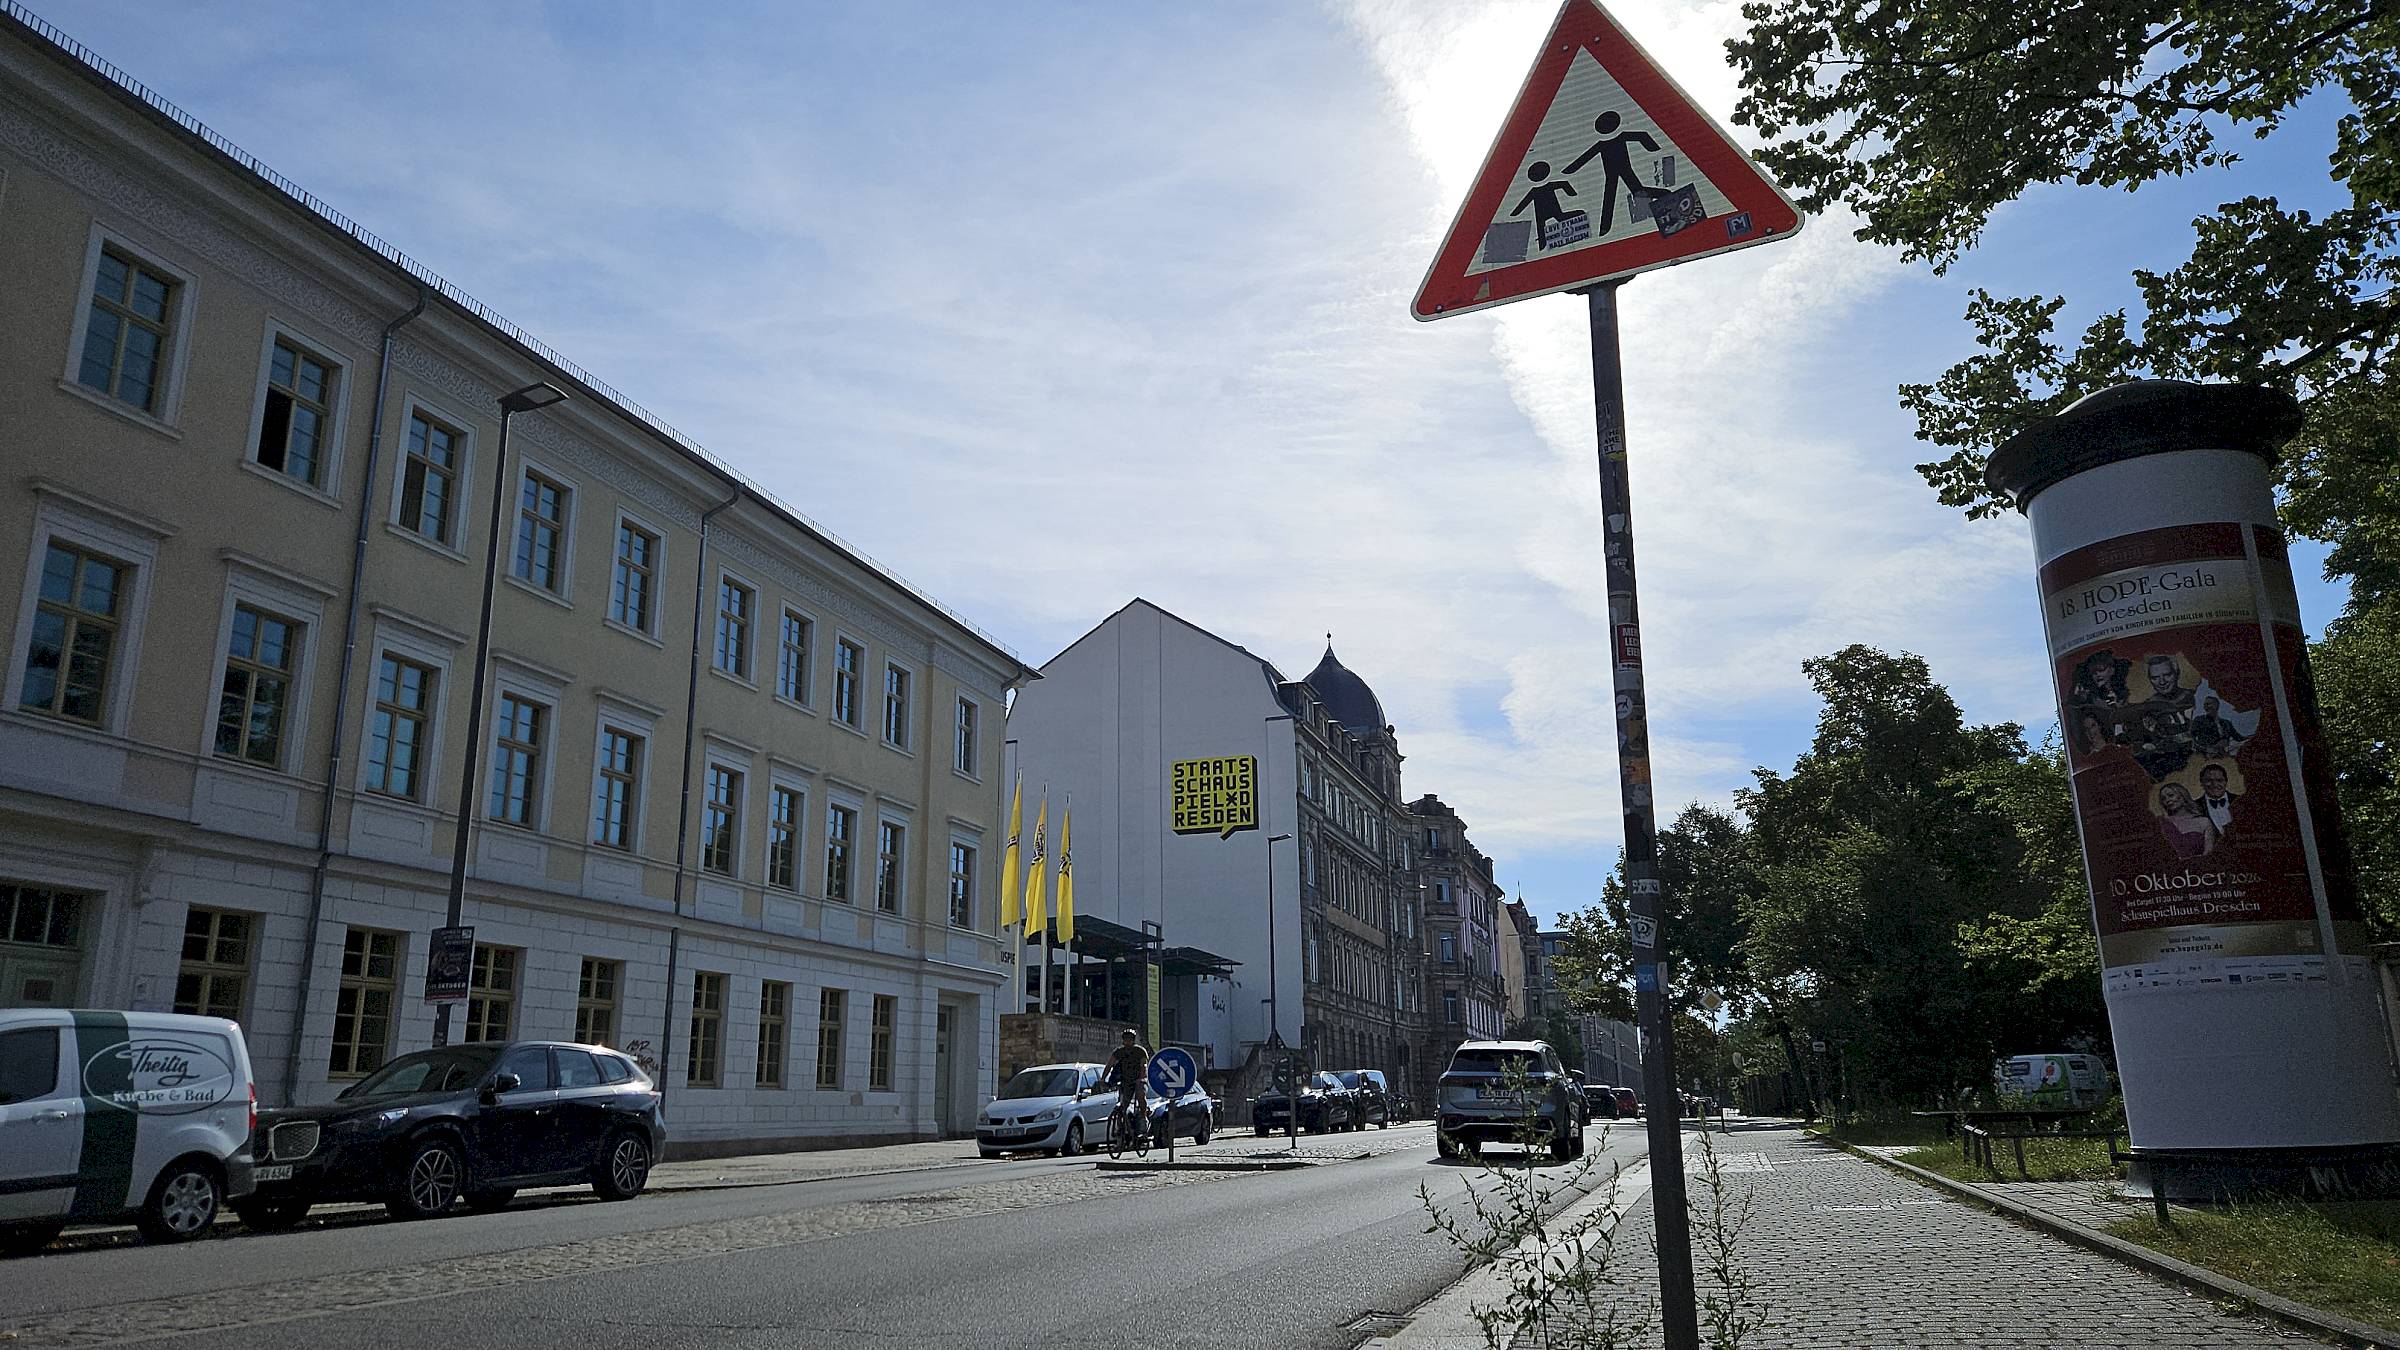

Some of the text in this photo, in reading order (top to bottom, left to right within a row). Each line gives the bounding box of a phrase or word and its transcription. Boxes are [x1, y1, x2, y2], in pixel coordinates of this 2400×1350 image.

[2060, 568, 2216, 620] 18. HOPE-Gala
[2094, 599, 2173, 625] Dresden
[1174, 758, 1250, 778] STAATS
[1174, 774, 1250, 794] SCHAUS
[1174, 807, 1251, 827] RESDEN
[2134, 869, 2226, 893] Oktober
[2120, 900, 2261, 922] Schauspielhaus Dresden
[115, 1045, 203, 1086] Theilig
[168, 1089, 181, 1101] &
[184, 1088, 216, 1101] Bad
